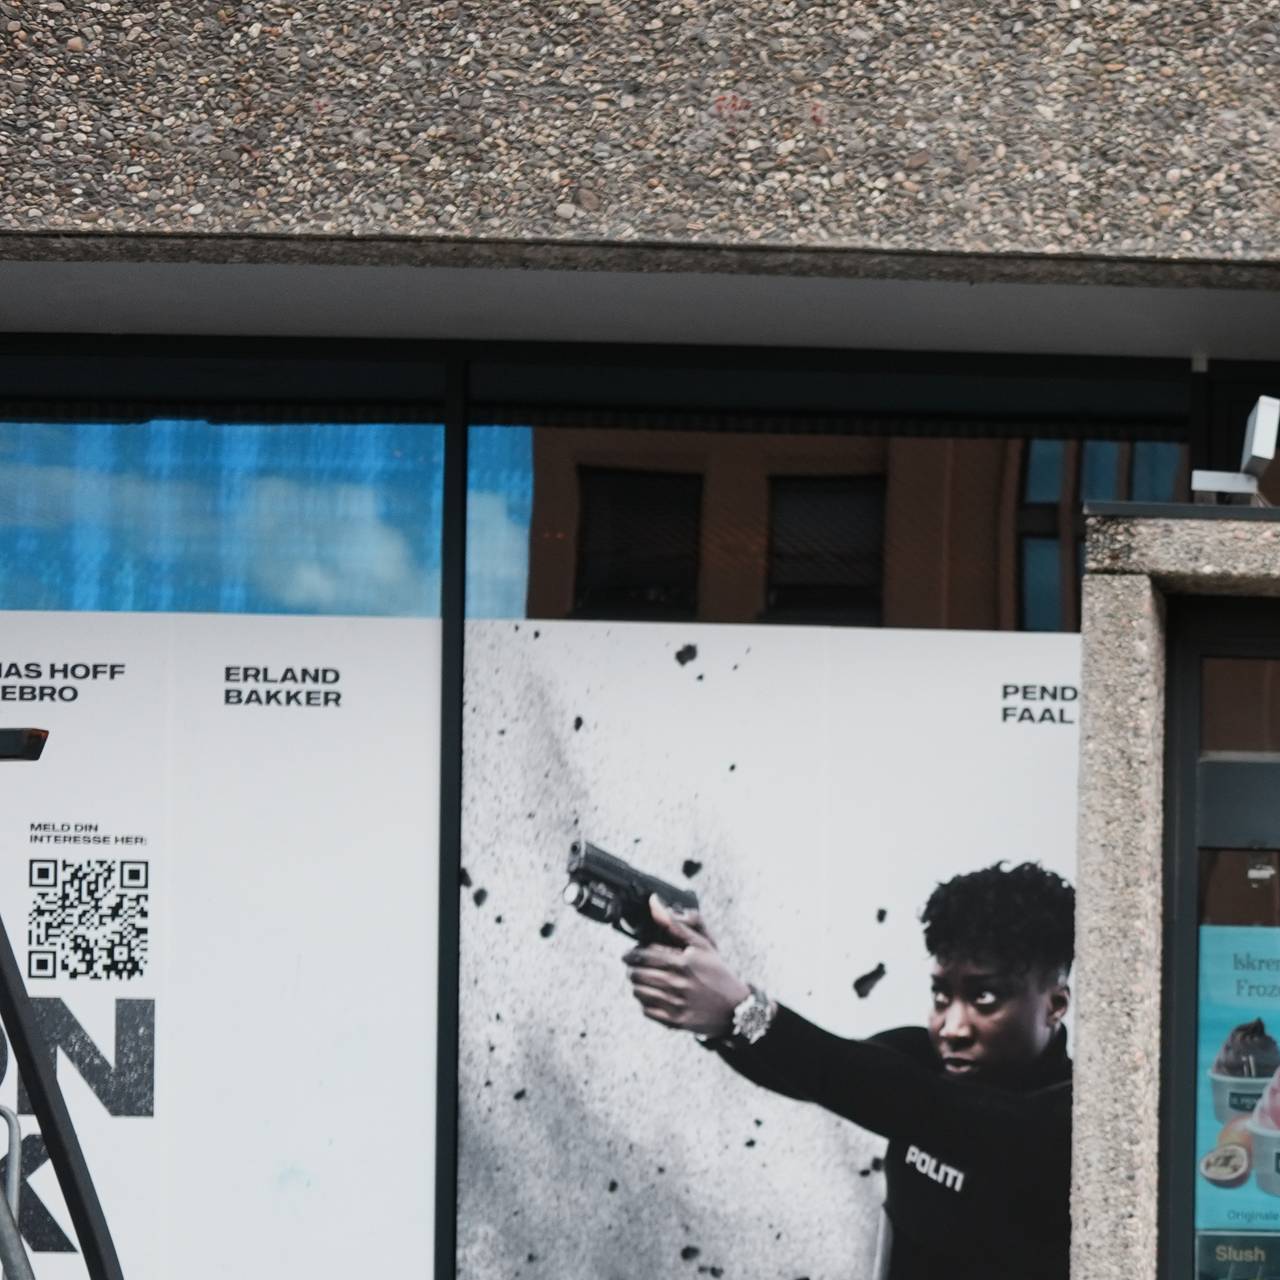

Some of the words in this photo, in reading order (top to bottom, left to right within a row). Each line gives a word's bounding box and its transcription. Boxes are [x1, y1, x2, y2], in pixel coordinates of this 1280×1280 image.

[0, 663, 42, 679] AS
[49, 663, 126, 680] HOFF
[224, 666, 341, 684] ERLAND
[1, 685, 78, 702] EBRO
[224, 689, 342, 707] BAKKER
[1003, 685, 1078, 701] PEND
[1002, 707, 1074, 724] FAAL
[30, 823, 70, 832] MELD
[74, 823, 98, 832] DIN
[29, 834, 111, 845] INTERESSE
[0, 997, 155, 1117] N
[904, 1145, 965, 1192] POLITI
[1215, 1245, 1266, 1262] Slush
